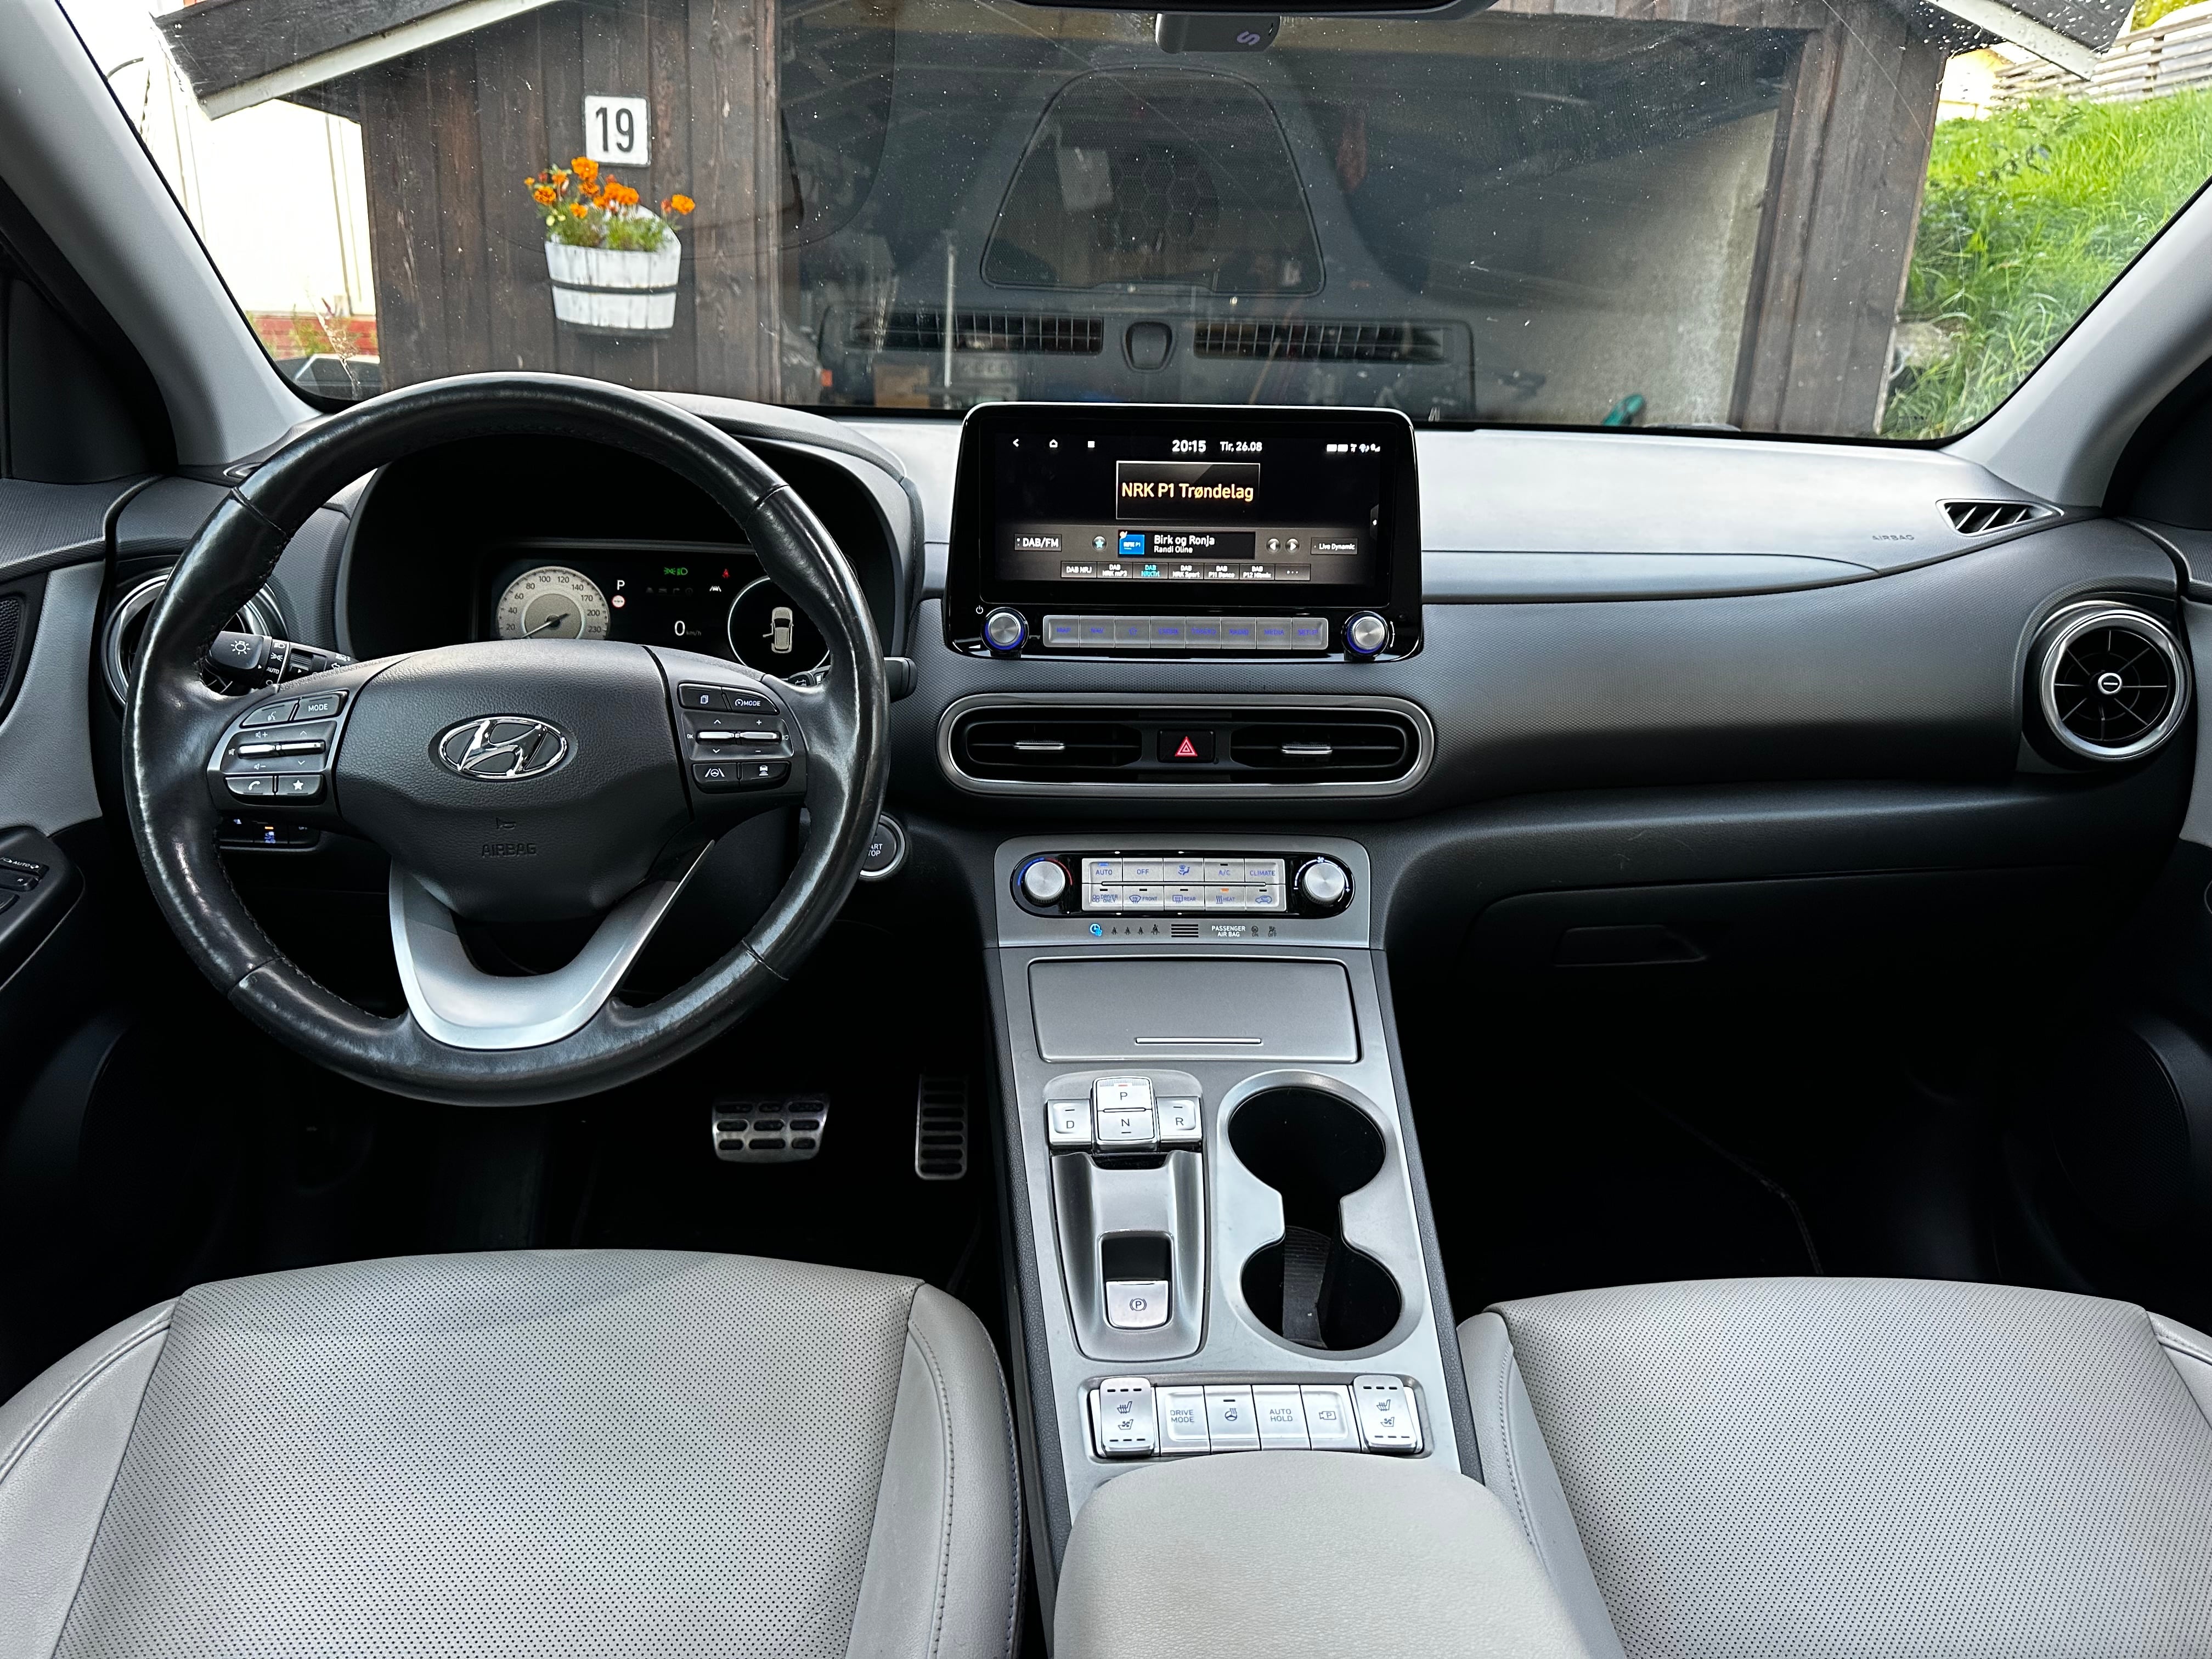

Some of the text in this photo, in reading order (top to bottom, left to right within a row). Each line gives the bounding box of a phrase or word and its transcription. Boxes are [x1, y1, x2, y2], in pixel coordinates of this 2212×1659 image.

[596, 107, 634, 153] 19
[1172, 440, 1206, 452] 20:15
[1236, 442, 1262, 452] 26.08
[1122, 483, 1254, 501] NRK P1 Trøndelag
[1022, 537, 1059, 548] DAB/FM
[1154, 535, 1215, 547] Birk og Ronja
[617, 580, 625, 590] P
[674, 620, 685, 636] 0
[266, 666, 280, 674] AUTO
[308, 703, 328, 712] MODE
[482, 843, 537, 857] AIRBAG
[1120, 1091, 1128, 1101] P
[1066, 1120, 1075, 1129] D
[1121, 1119, 1130, 1127] N
[1176, 1117, 1184, 1126] R
